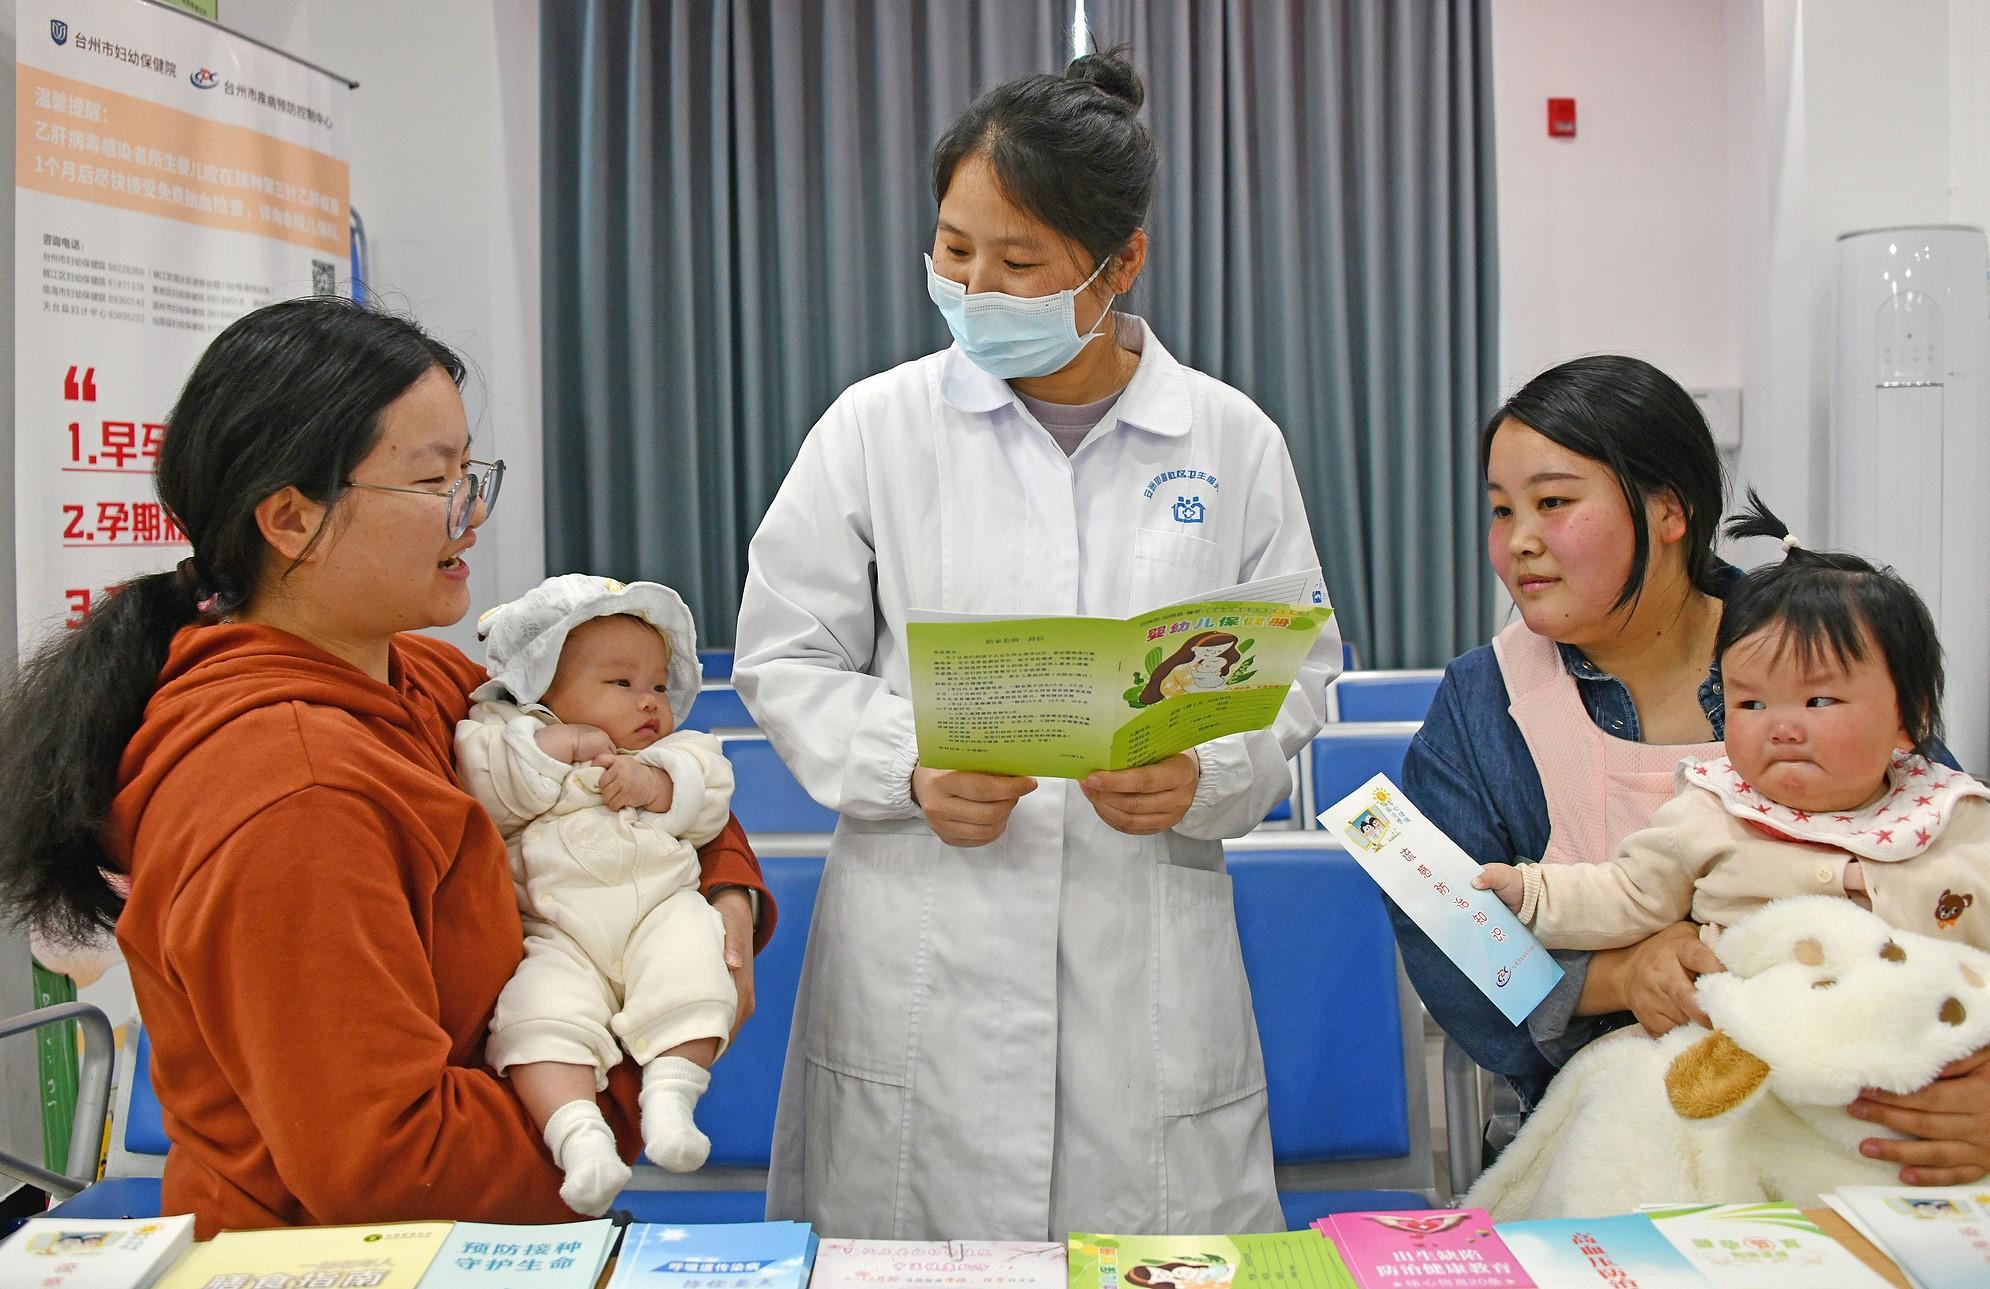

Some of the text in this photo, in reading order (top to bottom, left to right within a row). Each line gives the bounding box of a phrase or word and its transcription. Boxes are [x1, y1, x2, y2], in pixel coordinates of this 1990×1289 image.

[75, 32, 177, 78] 台州市妇幼保健院
[224, 80, 333, 130] 台州市疾病预防控制中心
[462, 1240, 582, 1256] 预防接种
[455, 1256, 576, 1272] 守护生命
